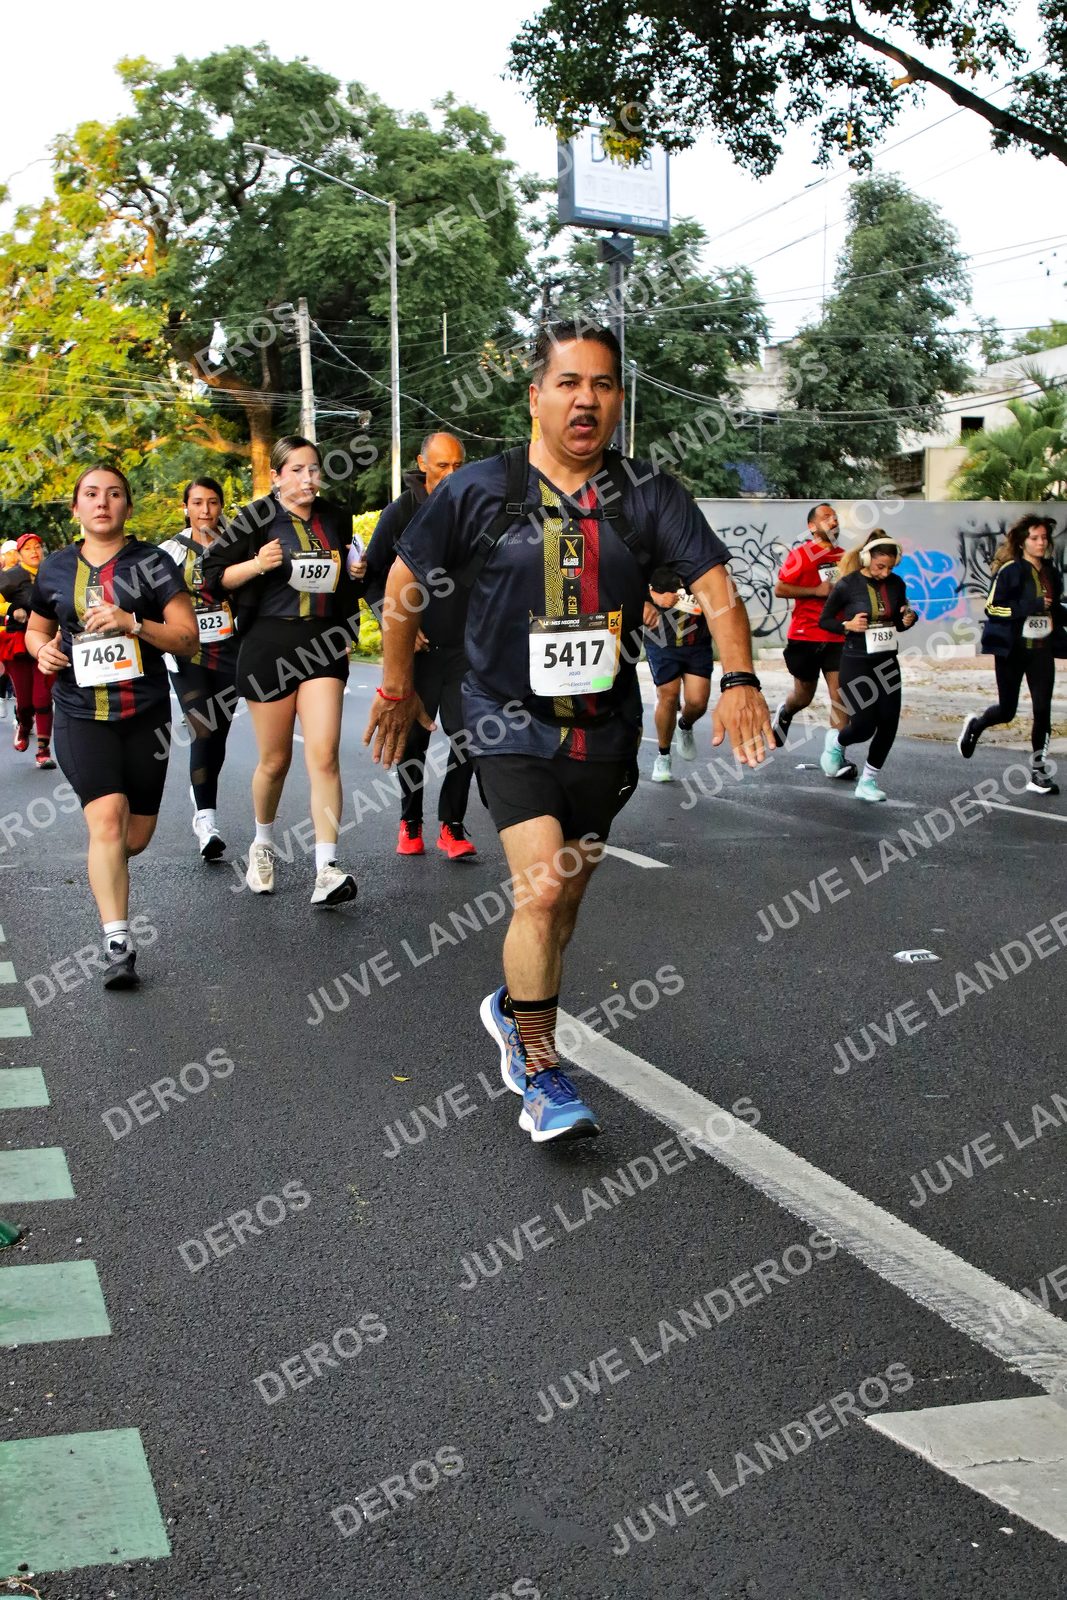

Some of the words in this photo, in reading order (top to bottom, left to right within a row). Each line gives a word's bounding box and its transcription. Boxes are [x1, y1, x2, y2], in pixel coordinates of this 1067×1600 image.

[717, 523, 767, 543] TOY
[300, 565, 330, 579] 1587
[200, 616, 223, 630] 823
[872, 631, 893, 642] 7839
[81, 643, 127, 667] 7462
[543, 640, 605, 669] 5417
